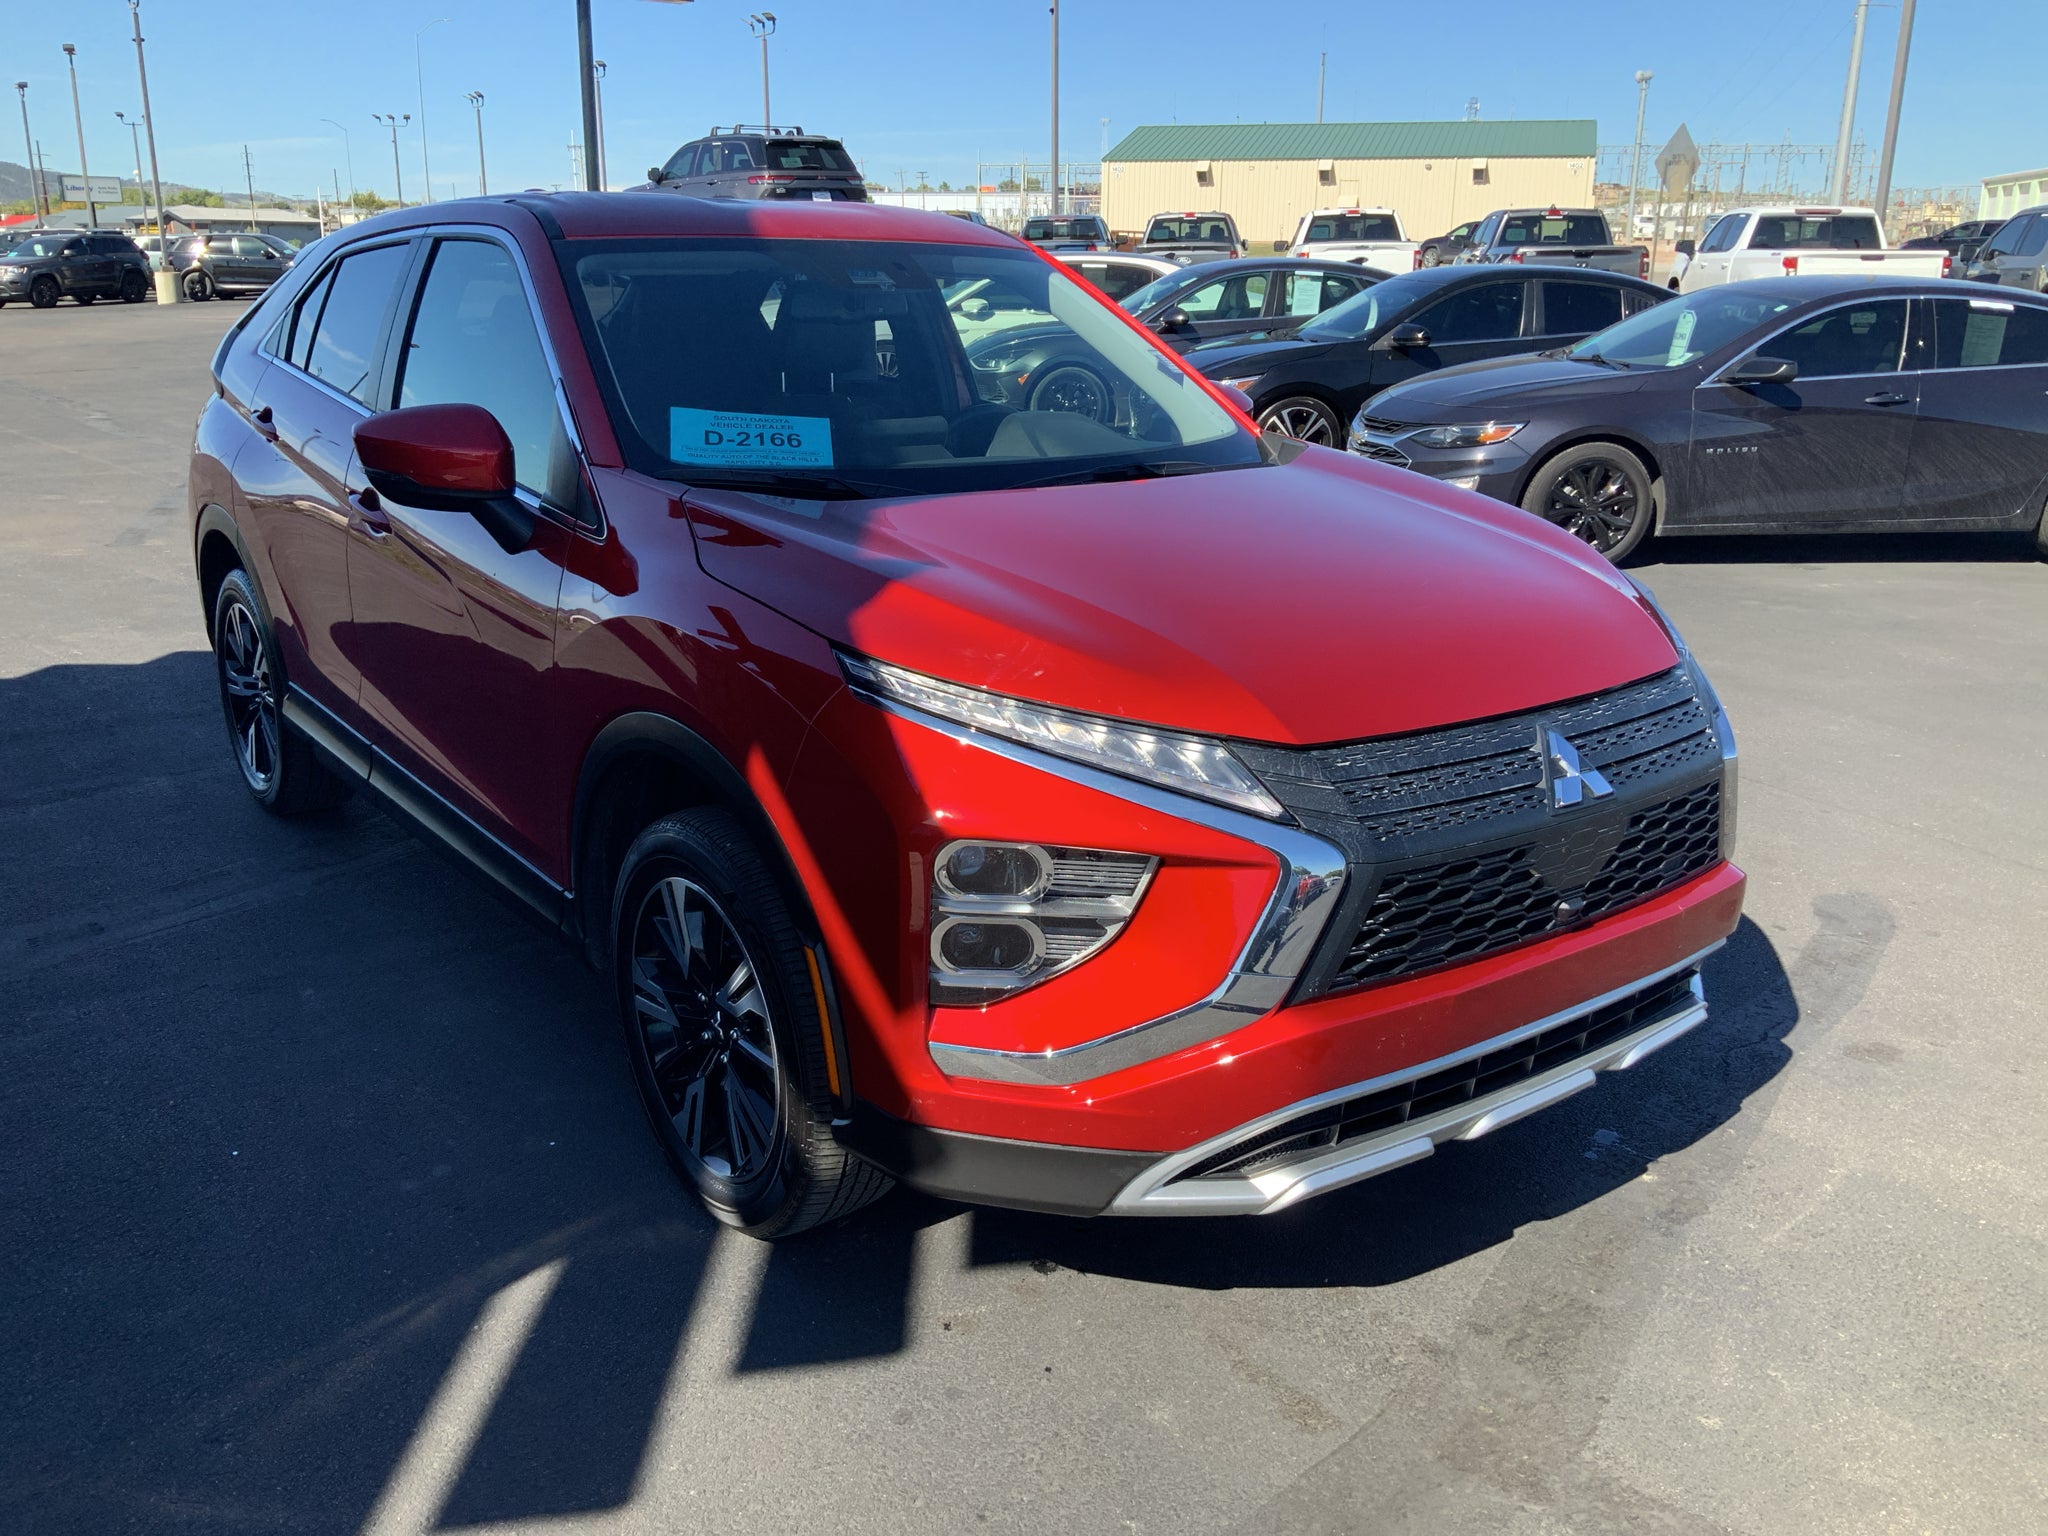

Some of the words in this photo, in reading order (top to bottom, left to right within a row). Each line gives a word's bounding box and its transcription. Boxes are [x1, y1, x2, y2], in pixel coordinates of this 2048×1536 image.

[754, 423, 794, 431] DEALER
[704, 429, 802, 449] D-2166
[1706, 446, 1758, 454] MALIBU
